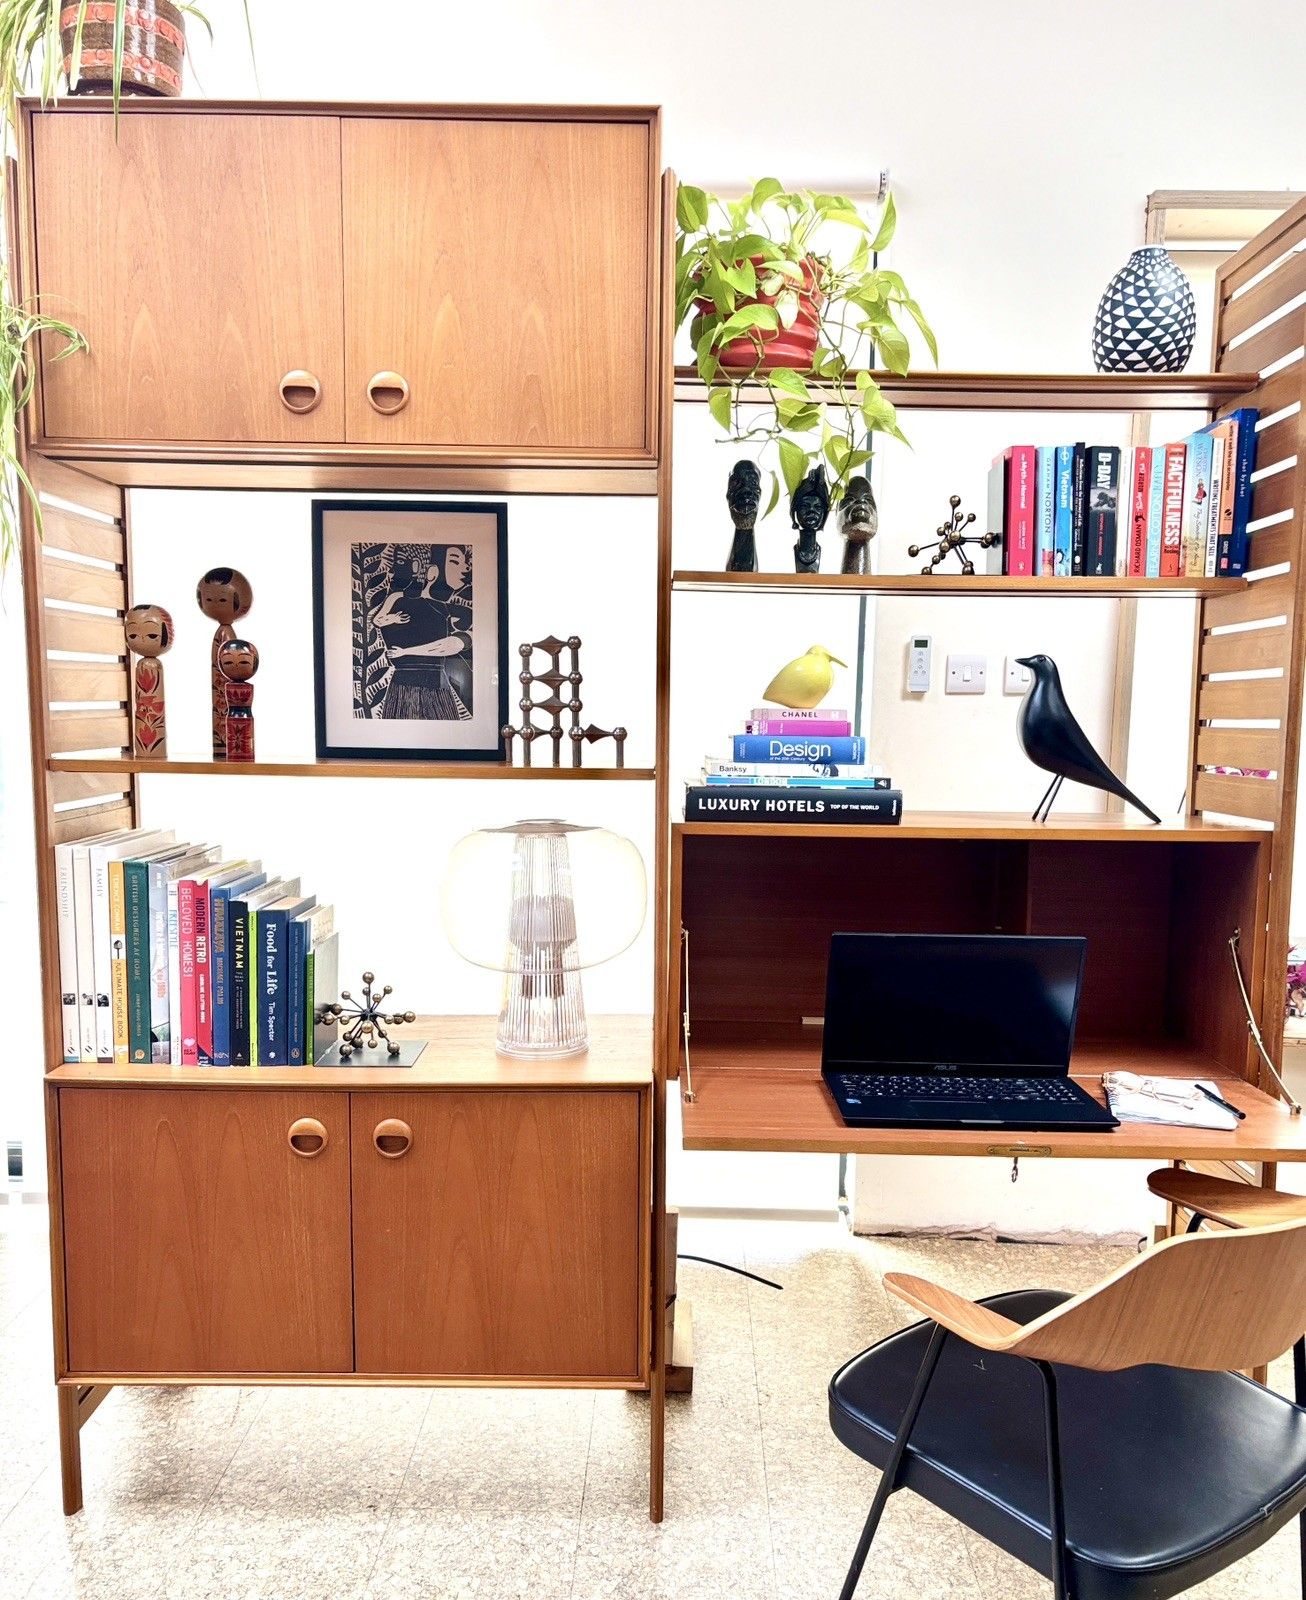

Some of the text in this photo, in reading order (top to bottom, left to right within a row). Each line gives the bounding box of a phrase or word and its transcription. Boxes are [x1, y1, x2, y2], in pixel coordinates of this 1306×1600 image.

[1061, 469, 1069, 508] Vietnam
[1098, 452, 1112, 489] D-DAY
[1152, 494, 1162, 535] COTTON
[1165, 456, 1184, 545] FACTFULNESS
[769, 740, 831, 761] Design
[698, 798, 760, 811] LUXURY
[766, 799, 825, 813] HOTELS
[182, 888, 192, 934] BELOVED
[195, 898, 206, 963] MODERN RETRO
[235, 918, 244, 969] VIETNAM
[267, 923, 278, 995] Food for Life
[267, 1016, 275, 1041] Spector
